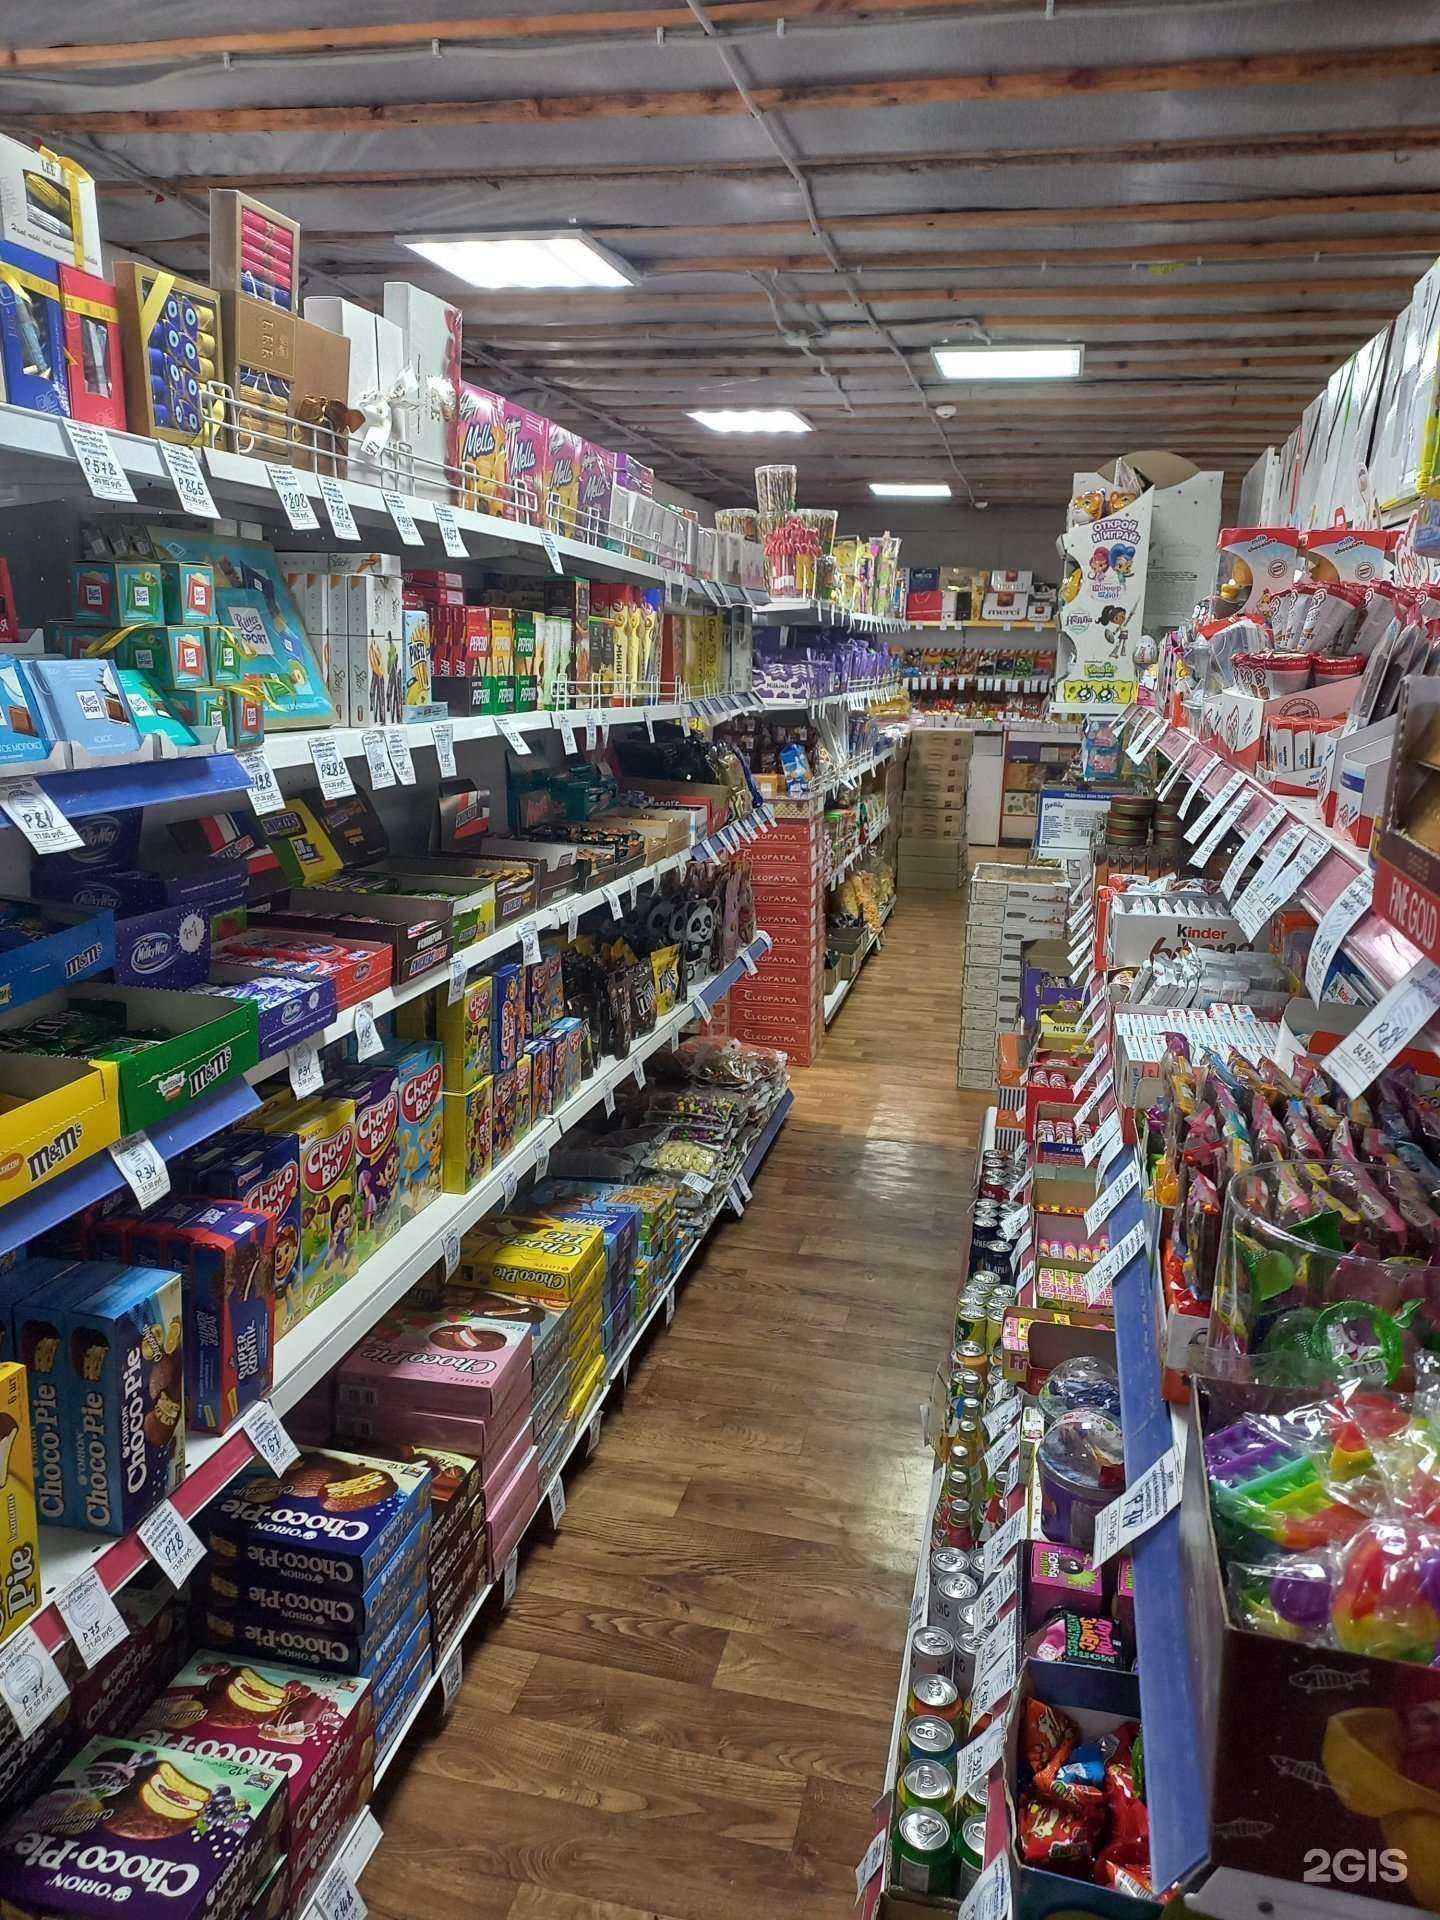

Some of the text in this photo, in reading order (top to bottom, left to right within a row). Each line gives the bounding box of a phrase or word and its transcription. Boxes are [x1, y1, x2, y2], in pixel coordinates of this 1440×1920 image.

[463, 424, 496, 460] Mella
[511, 440, 536, 474] Mella
[551, 458, 574, 488] Mella
[1093, 519, 1139, 531] ОТКРОЙ
[1091, 530, 1141, 545] И ИГРАЙ!
[1251, 535, 1267, 544] milk
[1338, 537, 1354, 546] milk
[988, 608, 1020, 616] merci
[241, 633, 268, 645] SPORT
[470, 636, 488, 652] PEPERO
[517, 637, 534, 652] PEPERO
[472, 688, 490, 706] PEPERO
[498, 687, 514, 704] PEPERO
[520, 687, 536, 702] PEPERO
[83, 705, 101, 713] SPORT
[1389, 877, 1438, 950] FINE GOLD
[1177, 923, 1228, 940] Kinder
[1053, 1025, 1076, 1033] NUTS
[501, 1236, 582, 1257] Choco
[493, 1266, 566, 1289] Choco Pie
[238, 1335, 249, 1380] SUPER
[407, 1352, 497, 1375] Choco
[253, 1521, 301, 1540] ORION
[7, 1541, 36, 1619] Pie
[45, 1872, 109, 1898] ORION
